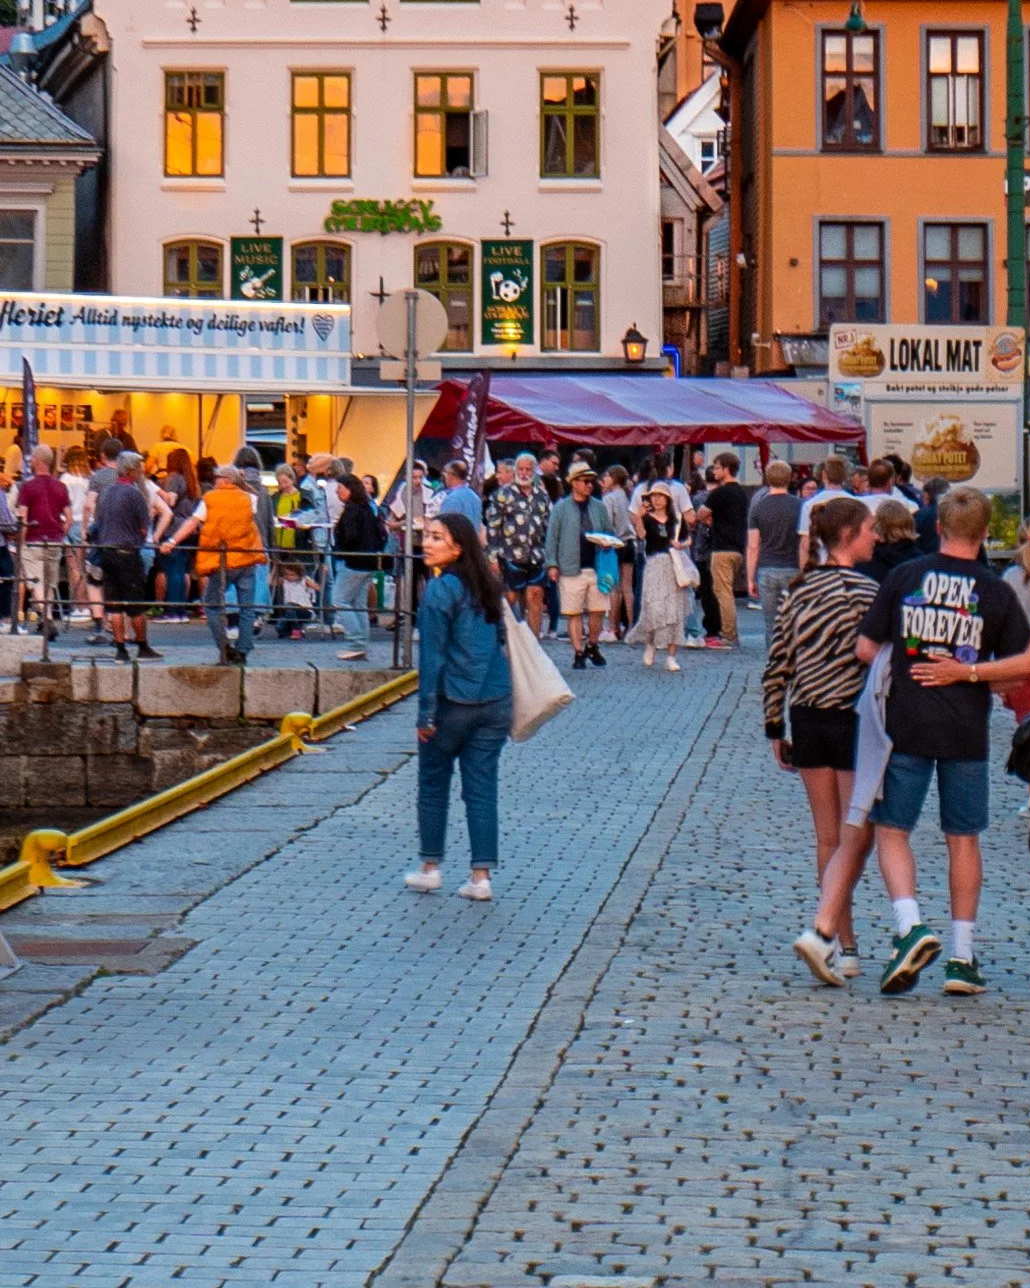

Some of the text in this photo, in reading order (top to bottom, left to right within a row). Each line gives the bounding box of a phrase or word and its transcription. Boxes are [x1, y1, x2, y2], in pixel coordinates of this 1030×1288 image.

[234, 254, 278, 265] MUSIC
[240, 243, 272, 253] LIVE
[491, 246, 522, 256] LIVE
[69, 306, 118, 326] Alltid
[121, 313, 183, 333] nystekte
[187, 318, 203, 335] og
[207, 317, 256, 338] deilige
[258, 317, 305, 335] vafler!
[889, 338, 942, 372] LOKAL
[946, 339, 982, 372] MAT
[923, 572, 976, 609] OPEN
[902, 605, 984, 651] FOREVER
